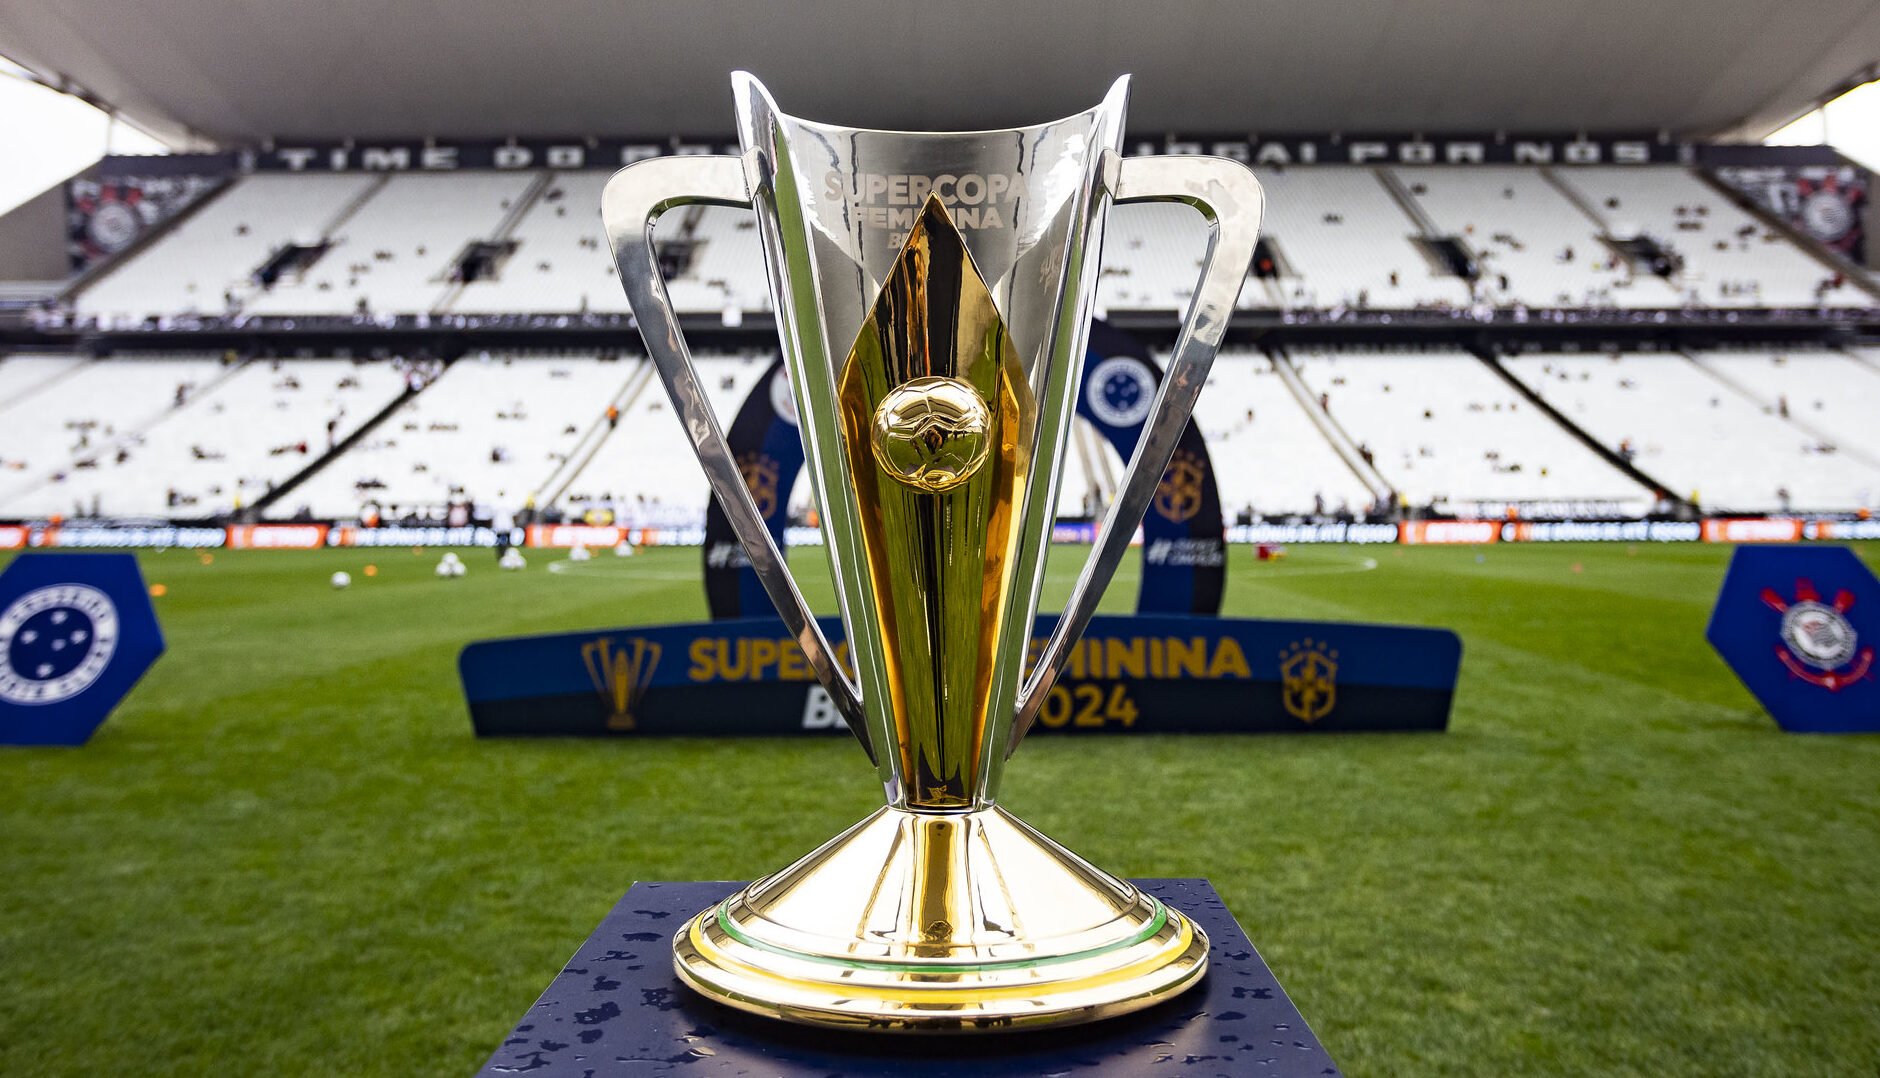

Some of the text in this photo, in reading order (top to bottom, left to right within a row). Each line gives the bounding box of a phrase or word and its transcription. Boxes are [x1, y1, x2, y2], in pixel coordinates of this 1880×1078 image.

[277, 146, 585, 170] TIME DO
[1347, 142, 1484, 164] POR
[825, 171, 1030, 206] SUPERCOPA
[850, 207, 1004, 230] FEMINA
[1036, 683, 1139, 728] 024
